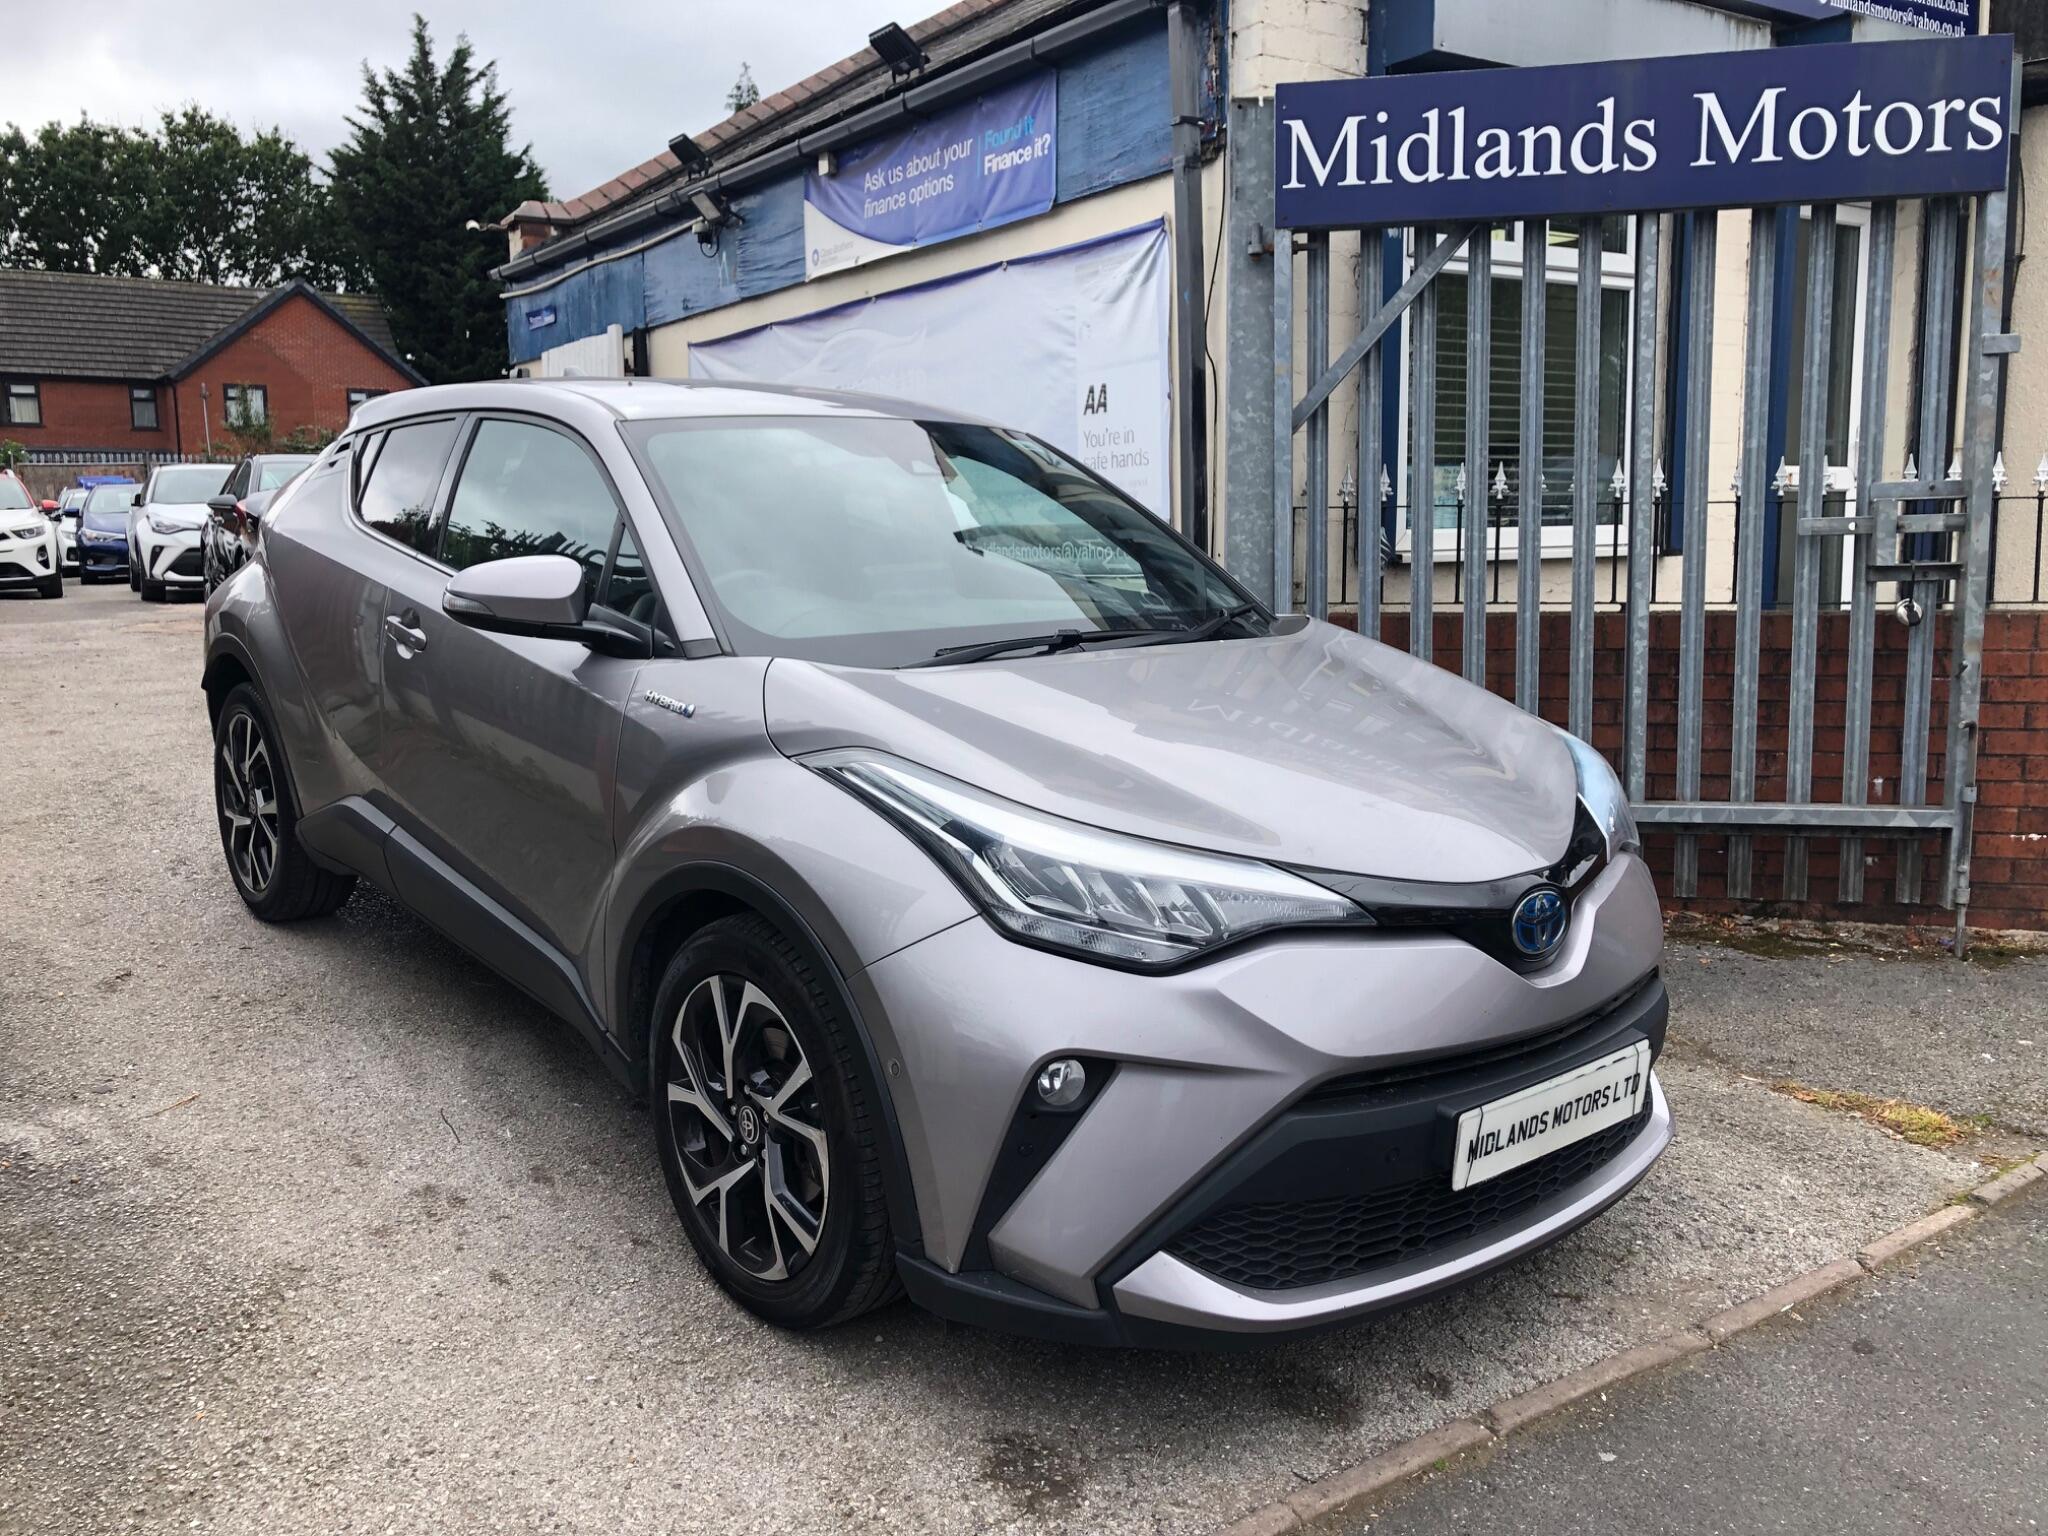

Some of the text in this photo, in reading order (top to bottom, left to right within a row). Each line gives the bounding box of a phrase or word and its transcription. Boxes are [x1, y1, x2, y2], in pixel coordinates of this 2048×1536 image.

[984, 119, 1022, 151] Found
[984, 133, 1051, 175] Finance it?
[1282, 87, 2003, 188] Midlands Motors
[865, 138, 973, 193] Ask us about your
[864, 174, 954, 219] finance options
[1083, 383, 1107, 415] AA
[1083, 425, 1134, 448] You're in
[1111, 448, 1149, 469] hands
[1467, 1073, 1641, 1163] MIDLANDS MOTORS LTD
